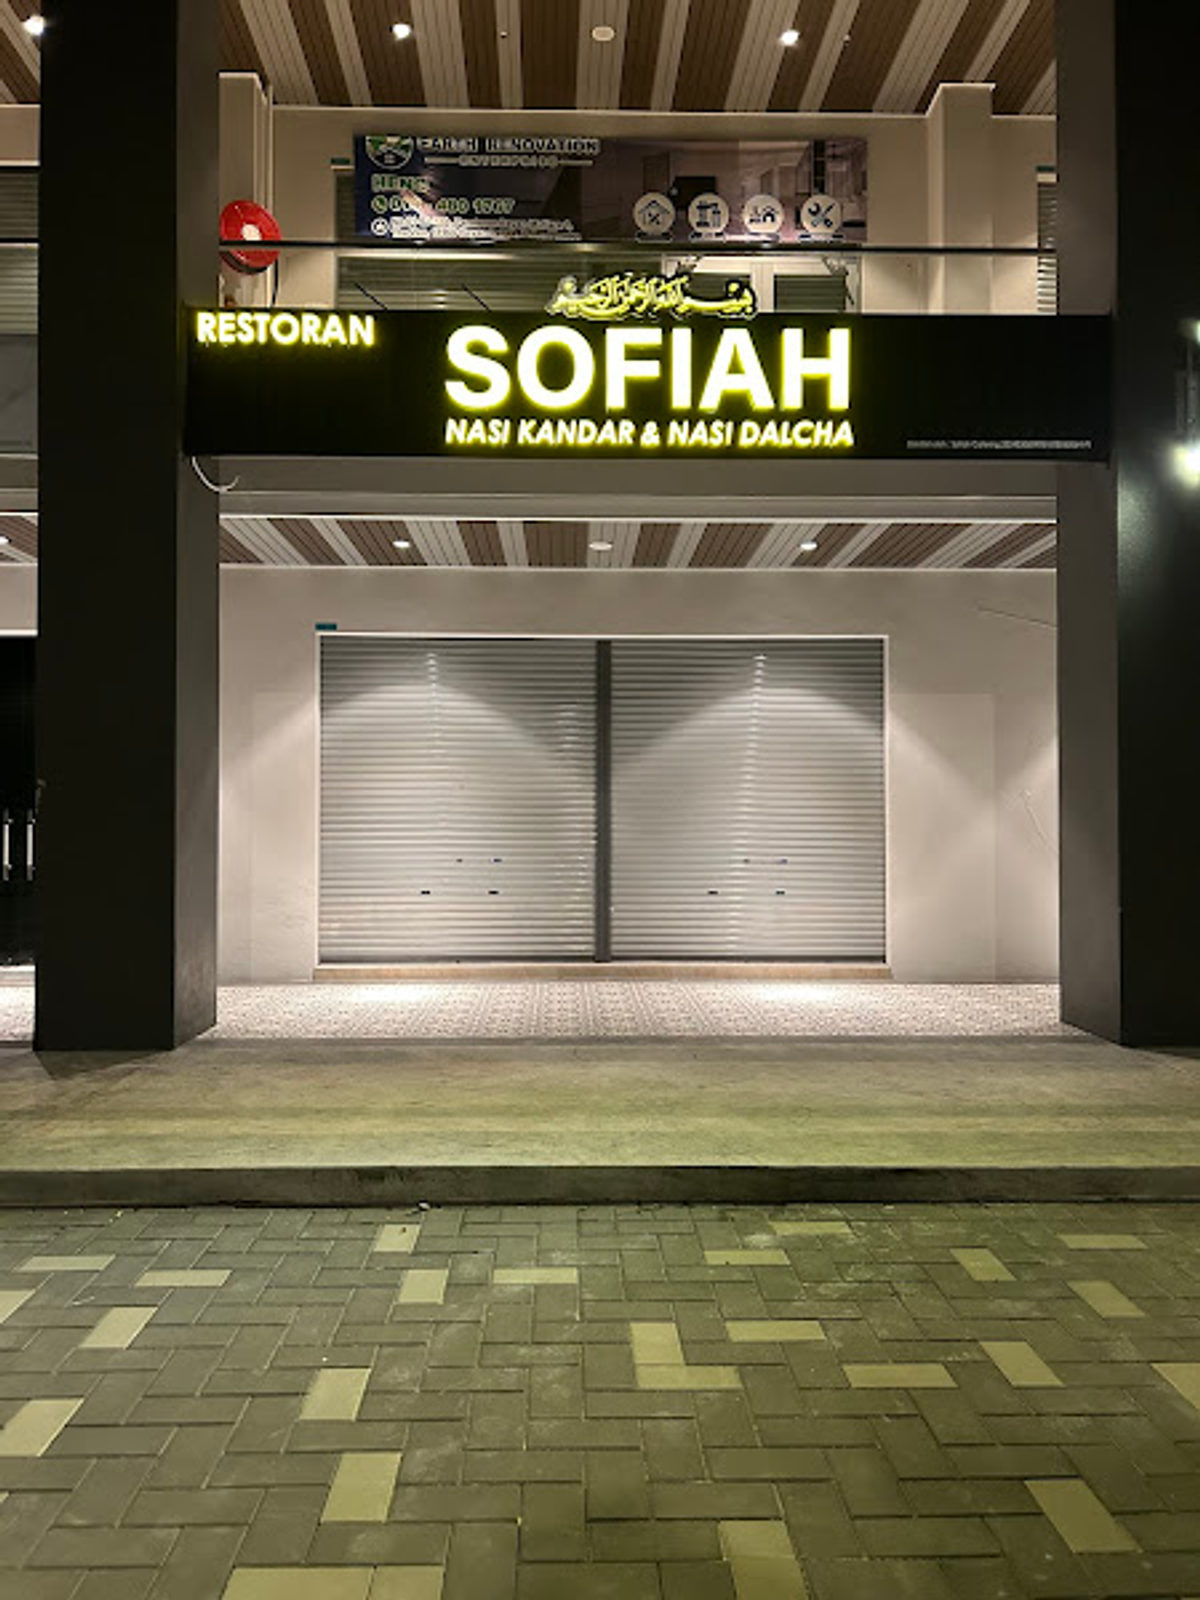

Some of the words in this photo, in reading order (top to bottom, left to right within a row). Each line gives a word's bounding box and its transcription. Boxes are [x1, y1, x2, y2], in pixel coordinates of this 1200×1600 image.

[485, 137, 601, 155] RENOVATION
[196, 311, 376, 347] RESTORAN
[444, 324, 851, 411] SOFIAH
[444, 417, 512, 446] NASI
[516, 418, 636, 447] KANDAR
[639, 421, 661, 447] &
[666, 420, 734, 447] NASI
[738, 419, 855, 449] DALCHA
